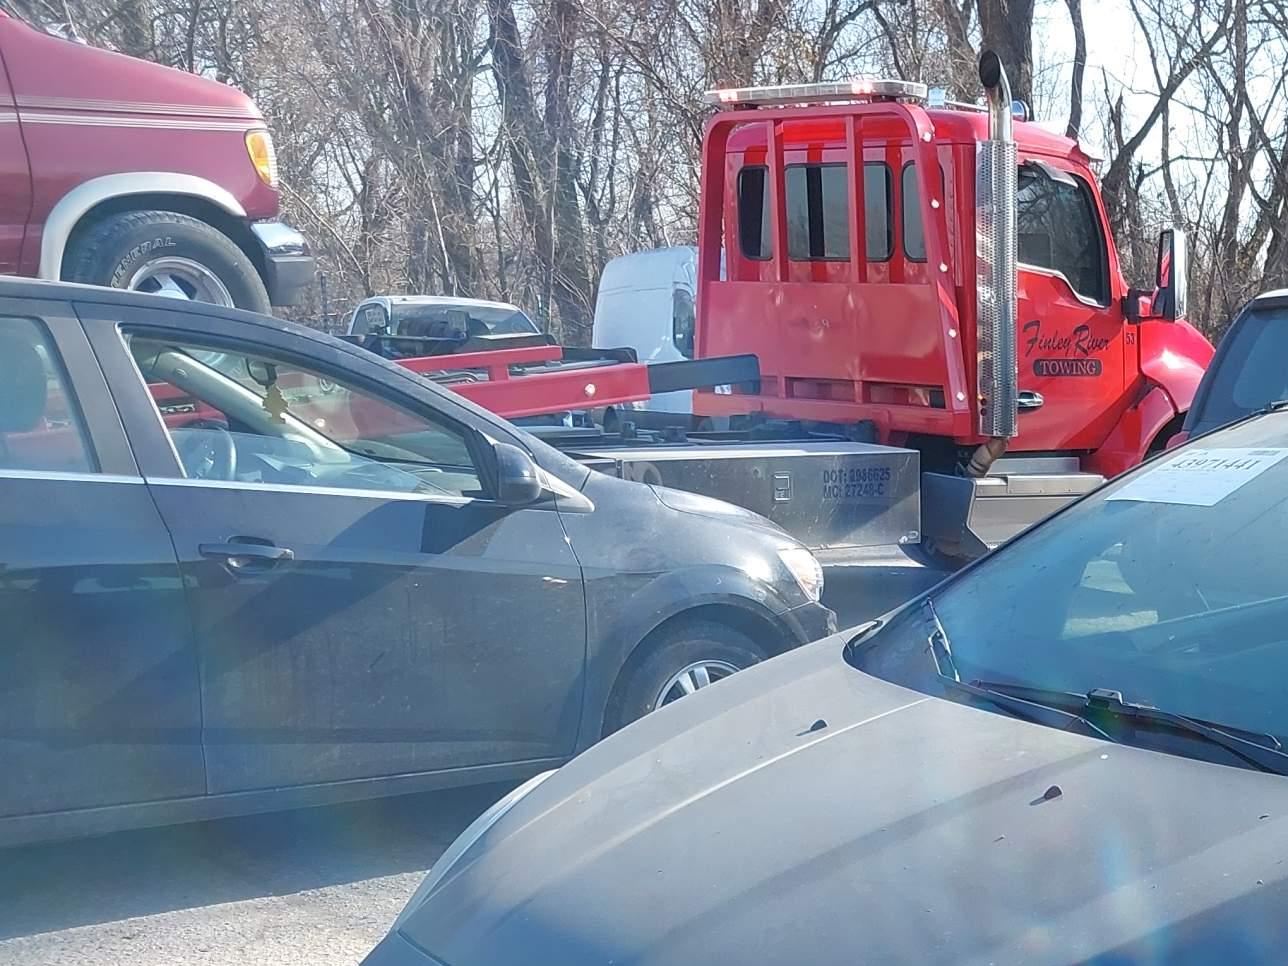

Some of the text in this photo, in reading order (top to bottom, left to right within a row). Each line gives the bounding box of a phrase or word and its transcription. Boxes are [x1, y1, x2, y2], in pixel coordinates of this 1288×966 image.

[1022, 319, 1111, 358] Finley River
[1126, 332, 1135, 345] 53
[1040, 361, 1097, 376] TOWING
[823, 469, 847, 484] DOT:
